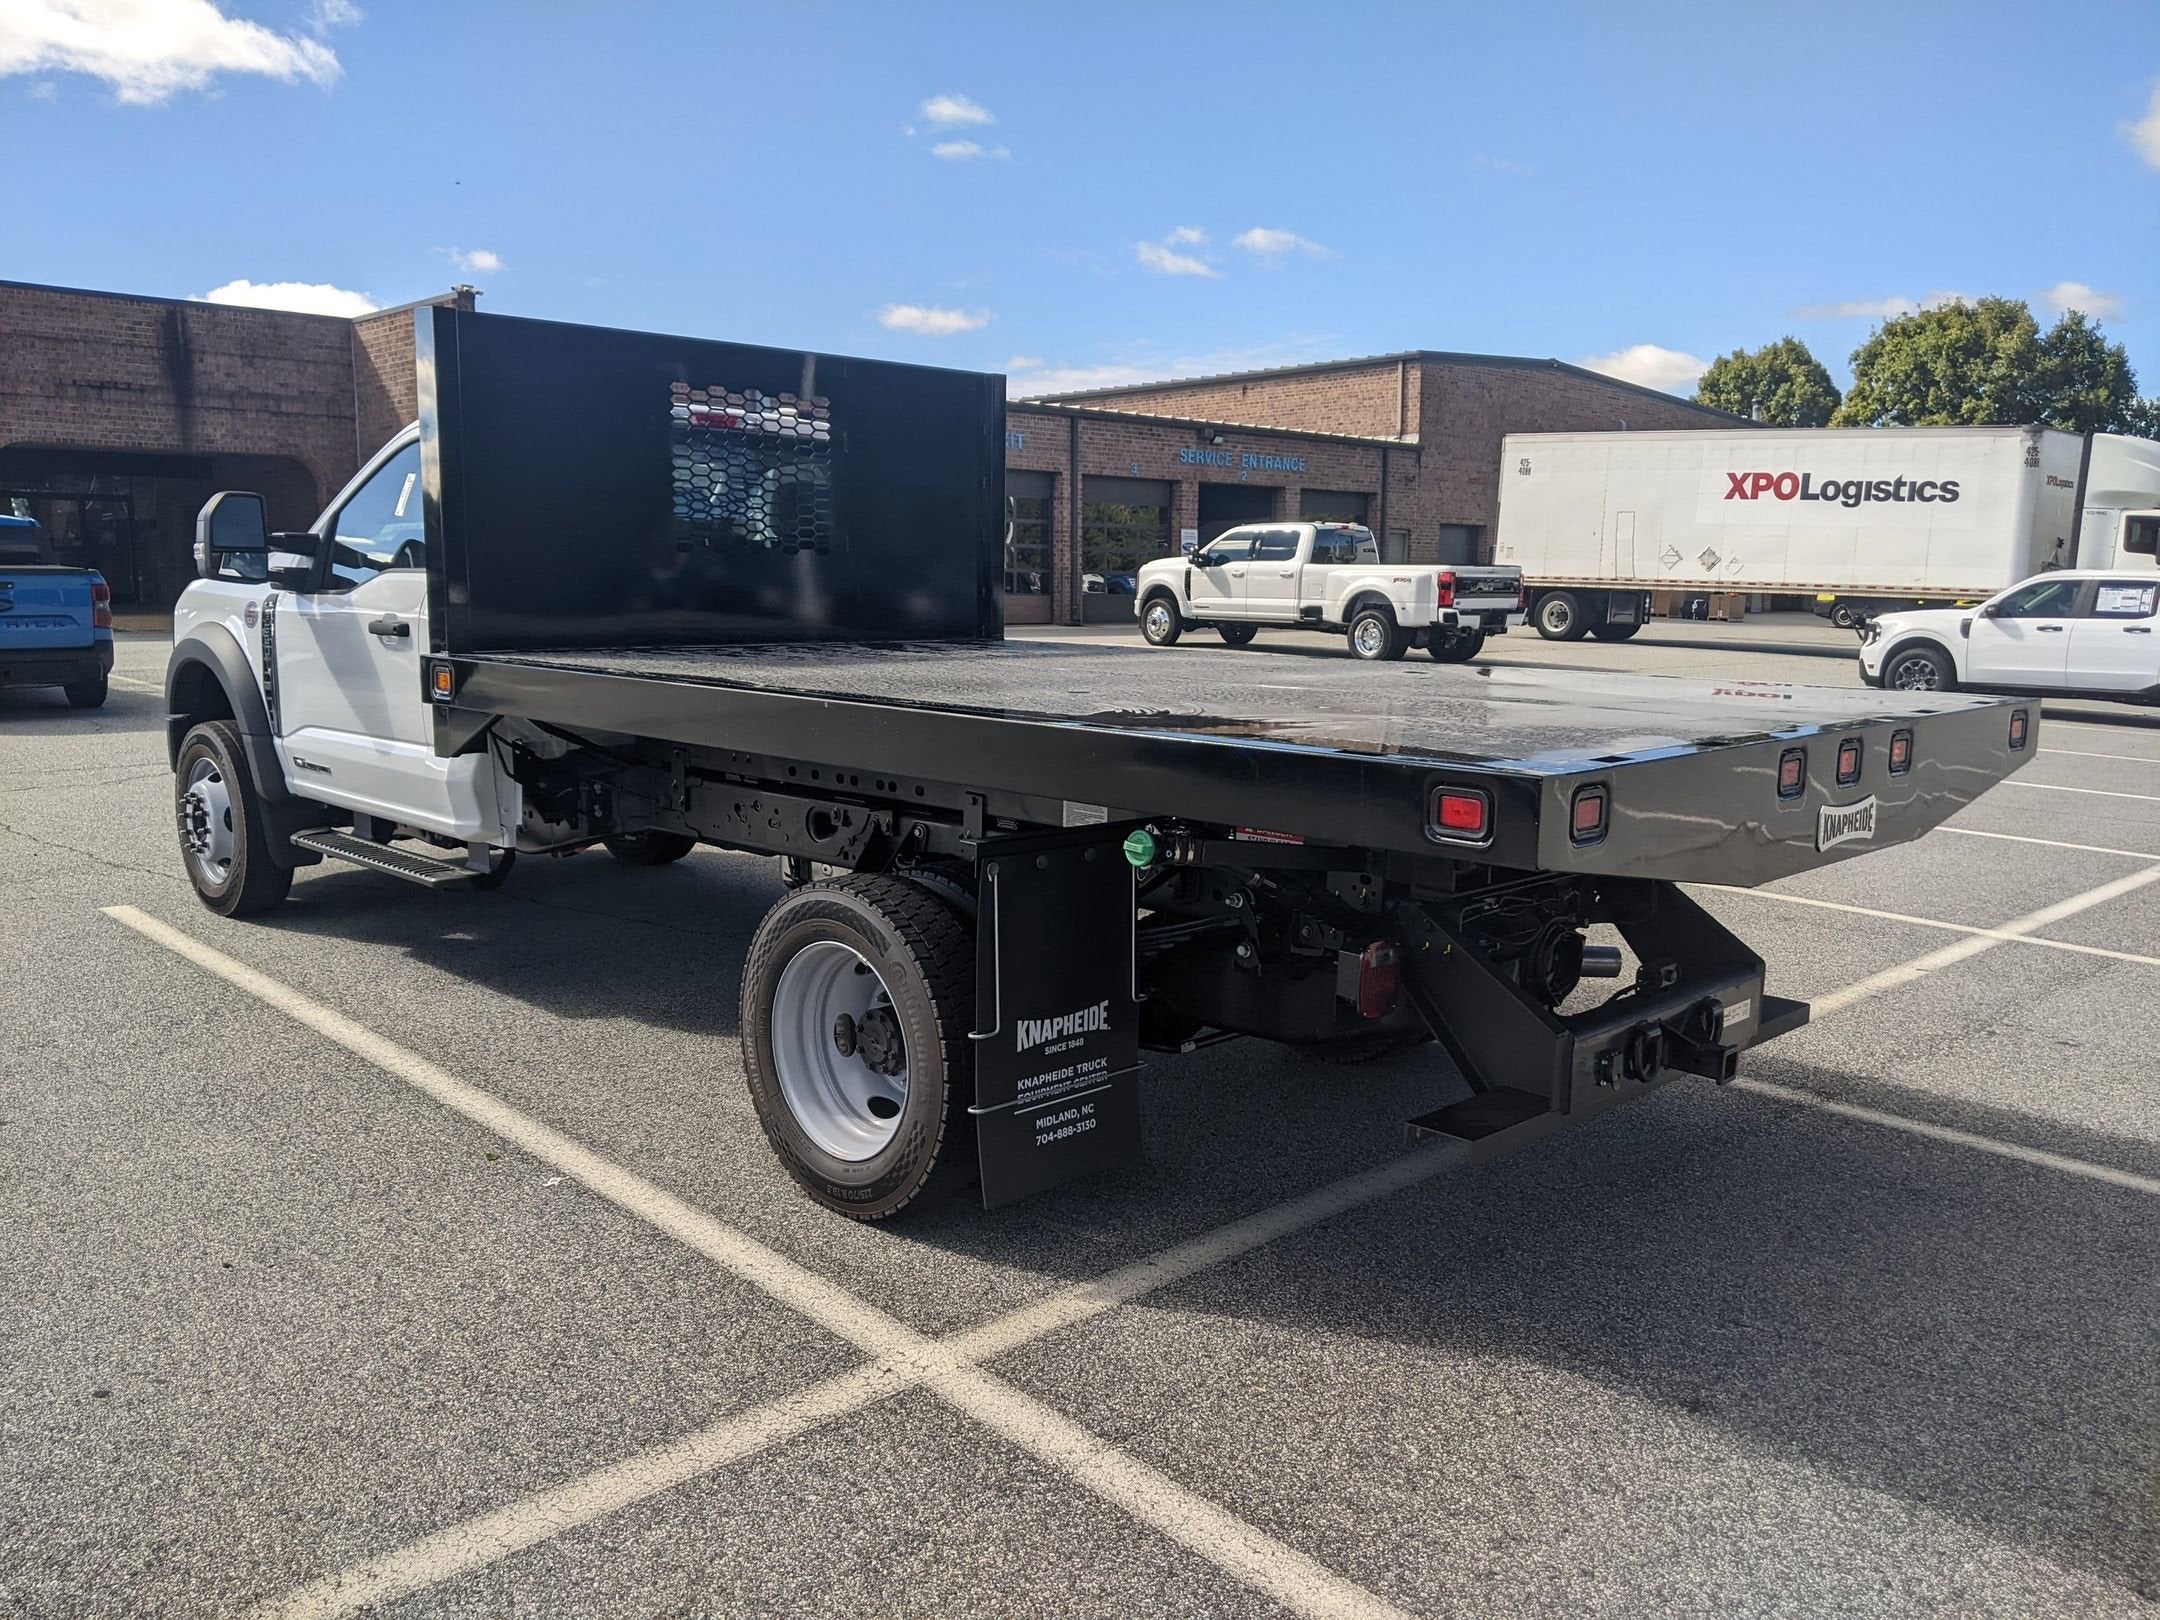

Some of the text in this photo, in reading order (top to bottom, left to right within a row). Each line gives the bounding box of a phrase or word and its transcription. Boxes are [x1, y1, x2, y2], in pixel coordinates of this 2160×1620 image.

[1180, 448, 1306, 472] SERVICE ENTRANCE
[1241, 471, 1248, 481] 2
[1822, 802, 1874, 845] KNAPHEIDE
[1017, 1000, 1109, 1052] KNAPHEIDE
[1044, 1038, 1084, 1055] SINCE 1848
[1017, 1057, 1108, 1091] KNAPHEIDE TRUCK
[1036, 1104, 1095, 1129] MIDLAND, NC
[1036, 1118, 1097, 1146] 704-888-3130
